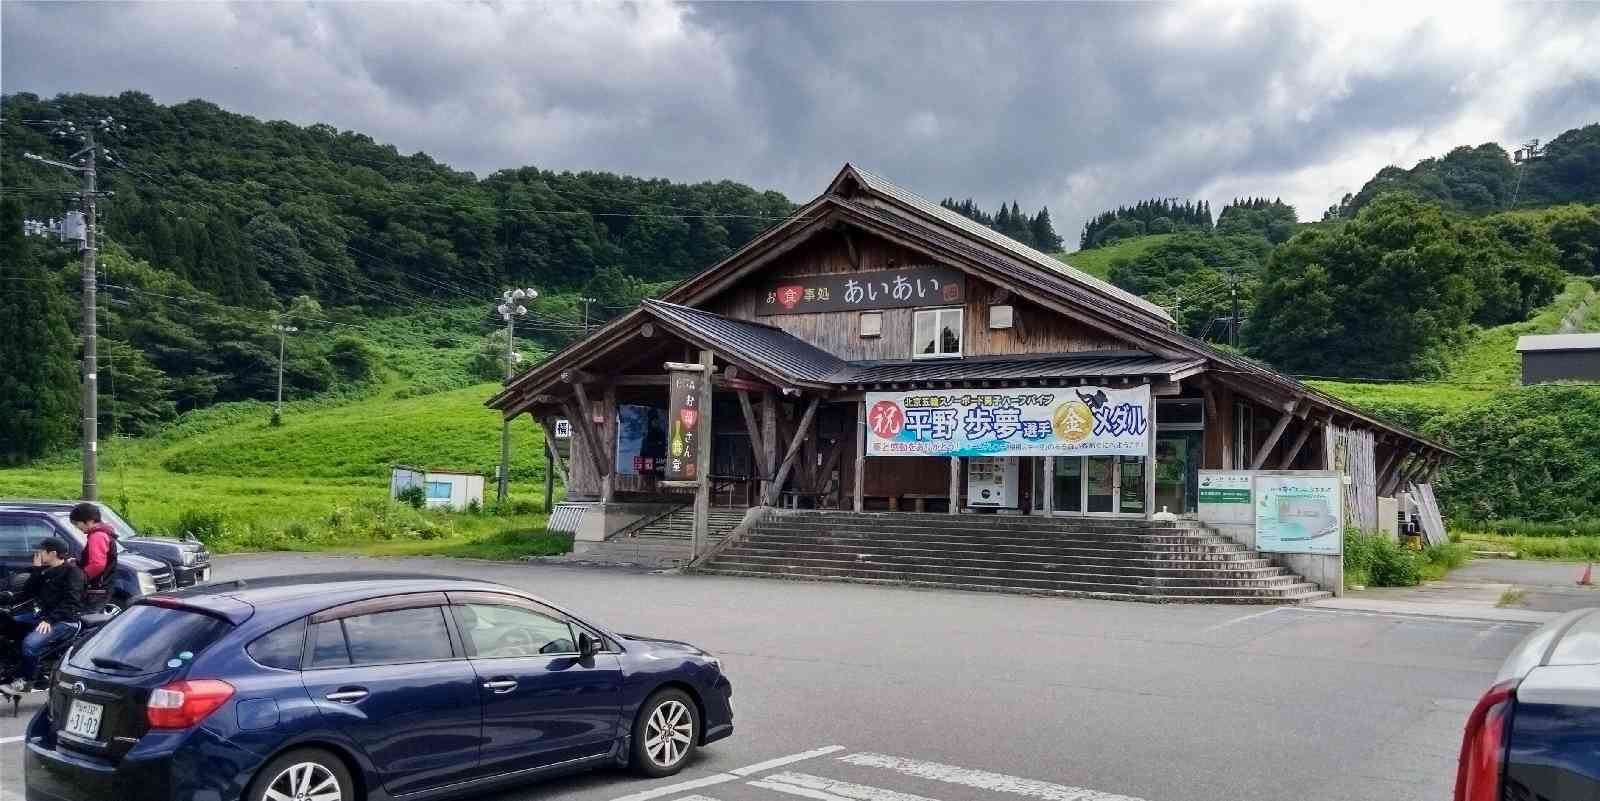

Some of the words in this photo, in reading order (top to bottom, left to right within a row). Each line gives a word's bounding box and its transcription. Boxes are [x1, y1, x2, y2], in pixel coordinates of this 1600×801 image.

[766, 286, 830, 305] お食事処
[843, 275, 939, 304] あいあい
[903, 394, 1055, 409] 北京五輪スノーボード男子ハーフパイプ
[872, 406, 901, 435] 祝
[905, 409, 959, 441] 平野
